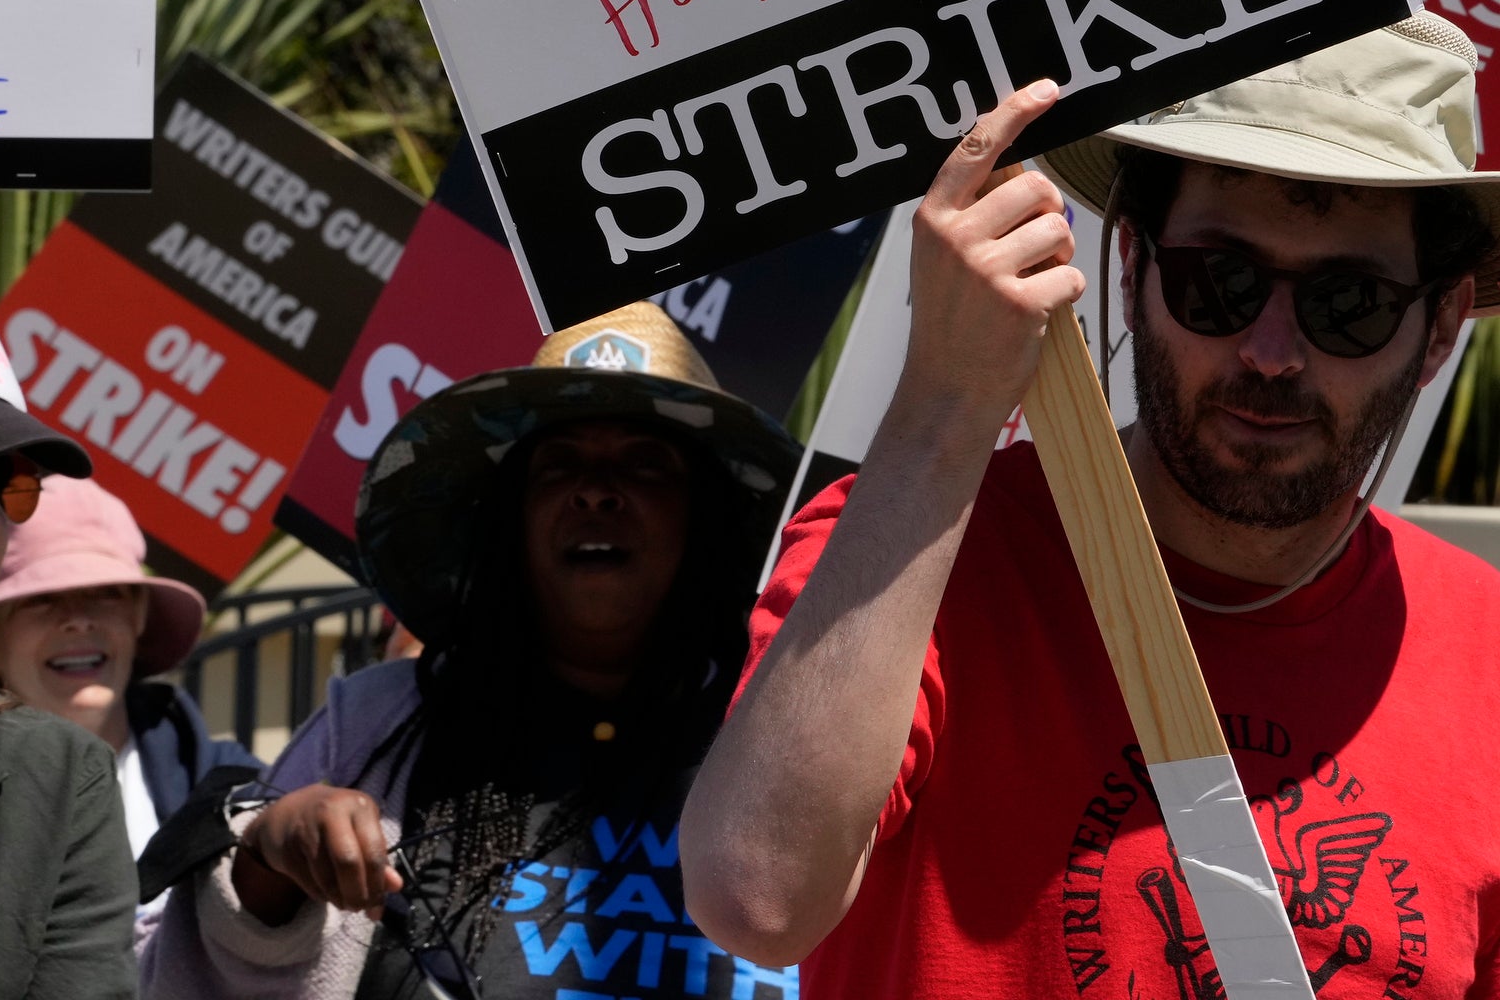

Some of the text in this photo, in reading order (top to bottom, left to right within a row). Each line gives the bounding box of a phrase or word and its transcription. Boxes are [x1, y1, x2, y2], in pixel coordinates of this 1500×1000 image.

[163, 98, 405, 285] WRITERS GUI
[243, 218, 294, 263] OF
[144, 324, 227, 397] ON
[147, 221, 319, 350] AMERICA
[5, 306, 288, 535] STRIKE!
[1062, 771, 1140, 996] WRITERS
[1219, 712, 1292, 759] ILD
[1311, 750, 1366, 807] OF
